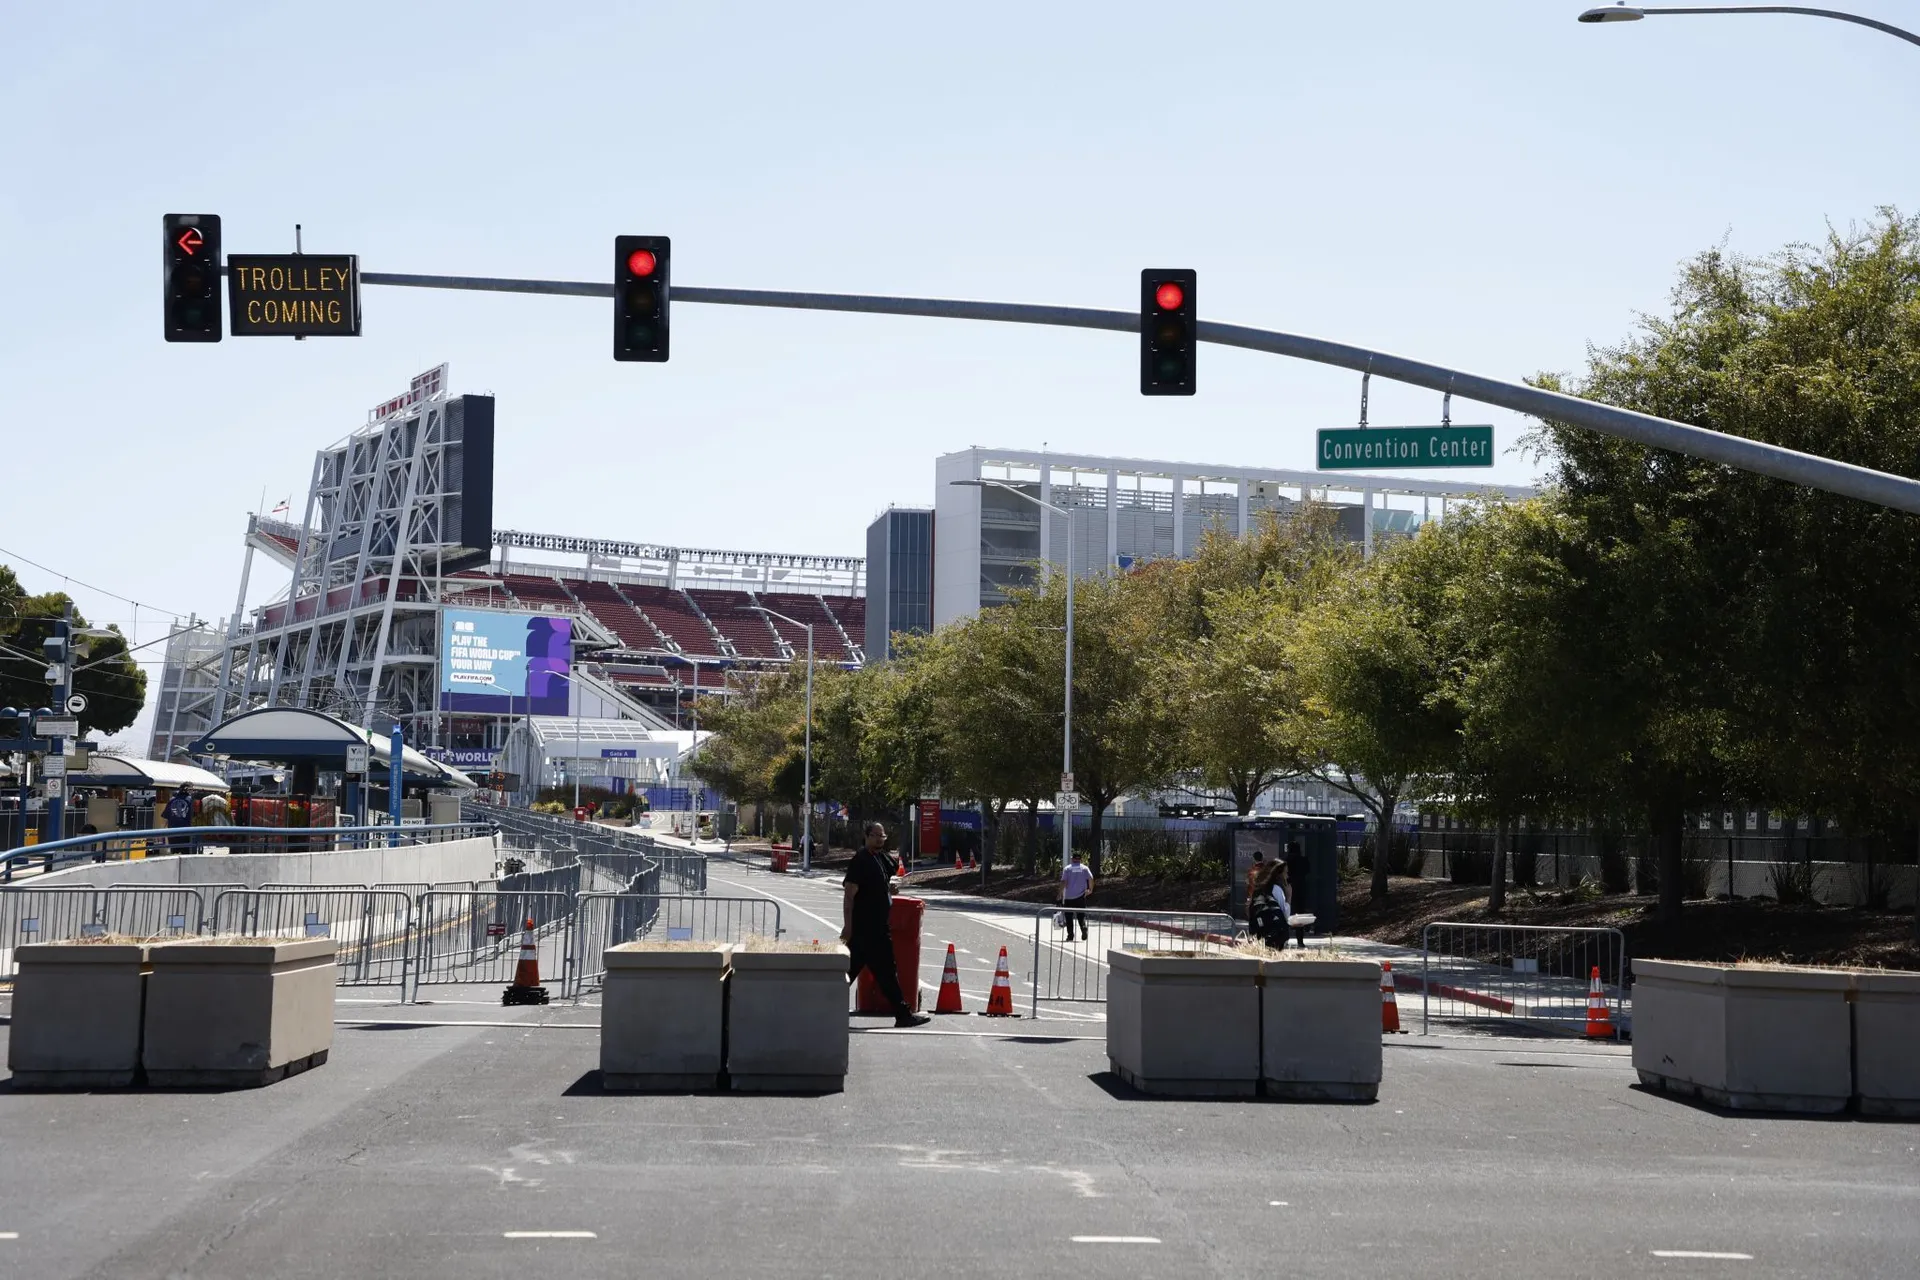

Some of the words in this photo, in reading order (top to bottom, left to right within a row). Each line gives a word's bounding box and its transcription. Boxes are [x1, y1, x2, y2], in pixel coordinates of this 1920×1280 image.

[236, 267, 349, 291] TROLLEY
[248, 300, 341, 323] COMING
[1323, 438, 1419, 460] Convention
[1429, 436, 1487, 458] Center
[451, 634, 472, 646] PLAY
[472, 636, 488, 648] THE
[451, 646, 468, 658] FIFA
[469, 647, 498, 660] WORLD
[450, 658, 473, 670] YOUR
[473, 660, 492, 671] WAY
